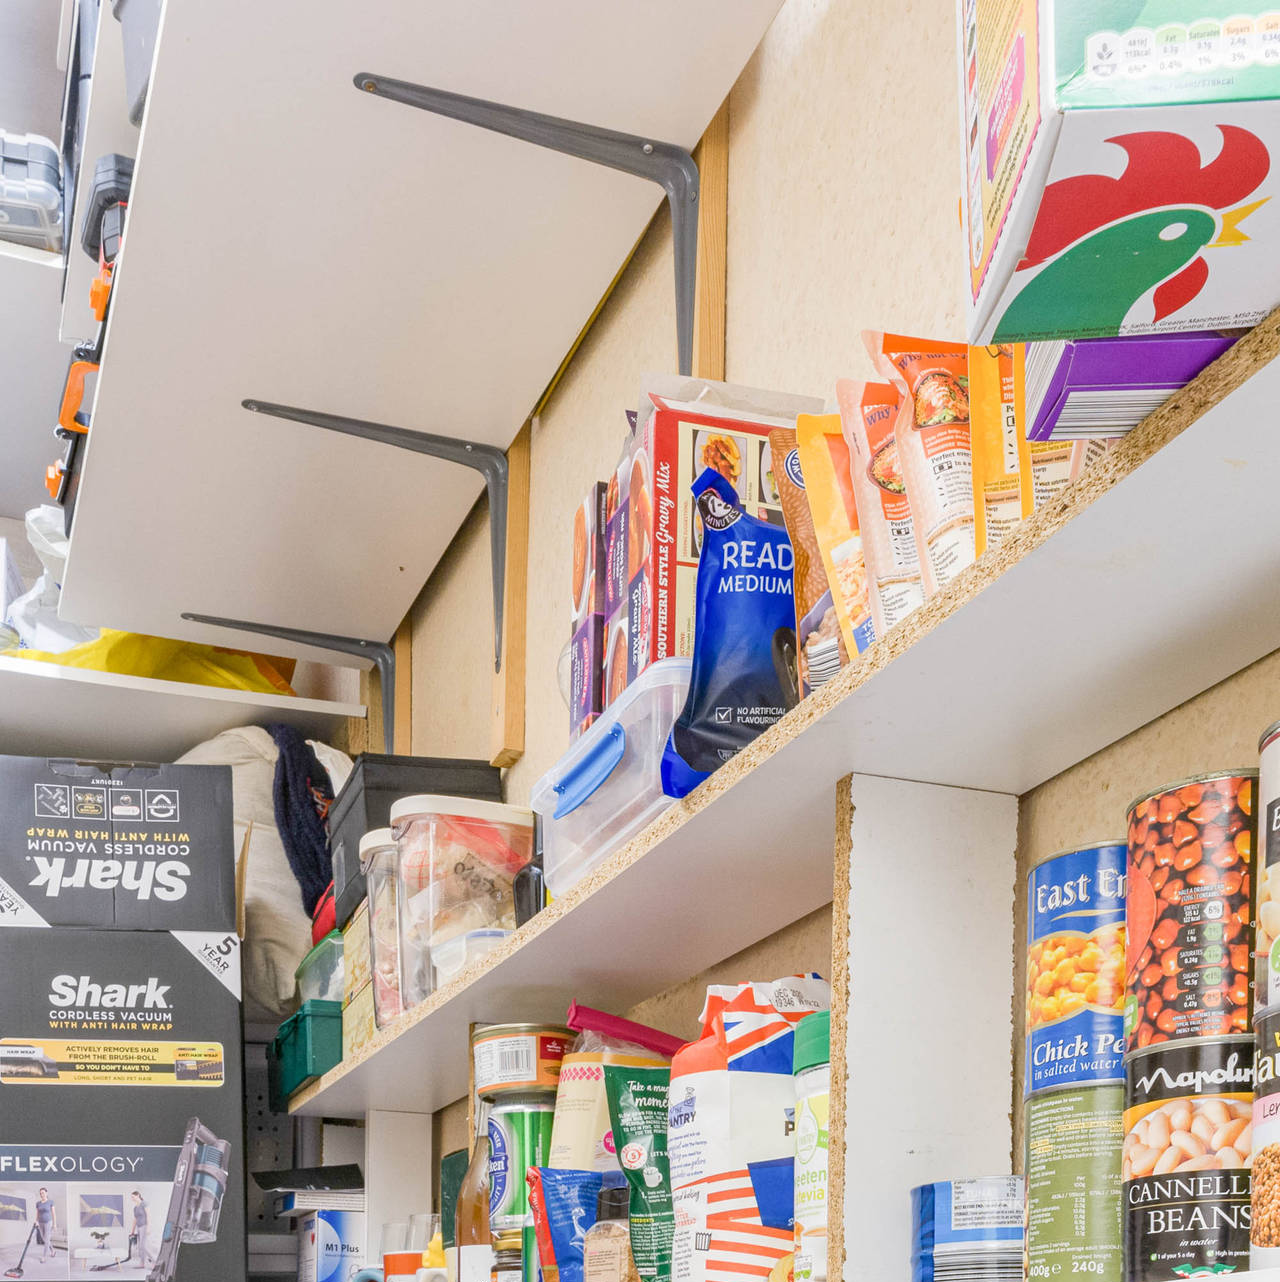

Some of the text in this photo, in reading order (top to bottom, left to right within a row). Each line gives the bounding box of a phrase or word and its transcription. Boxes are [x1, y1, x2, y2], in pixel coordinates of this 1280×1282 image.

[656, 462, 675, 660] SOUTHERN STYLE Gravy Mix
[718, 575, 793, 595] MEDIUM
[737, 707, 748, 715] NO
[26, 826, 191, 843] WITH ANTI HAIR WRAP
[27, 840, 191, 856] CORDLESS VACUUM
[28, 856, 192, 902] Shark
[1036, 873, 1091, 914] East
[216, 936, 238, 956] 5
[202, 943, 230, 972] YEAR
[48, 974, 173, 1009] Shark
[49, 1010, 173, 1022] CORDLESS VACUUM
[49, 1020, 174, 1031] WITH ANTI HAIR WRAP
[66, 1045, 101, 1053] ACTIVELY
[68, 1053, 91, 1061] FROM
[1032, 1032, 1089, 1068] Chick
[1034, 1058, 1120, 1081] in salted water
[626, 1079, 646, 1093] Take
[0, 1155, 141, 1173] FLEXOLOGY
[325, 1243, 360, 1253] M1 Plus
[1179, 1238, 1218, 1247] in water
[1029, 1264, 1050, 1279] 400g
[1072, 1260, 1104, 1275] 240g
